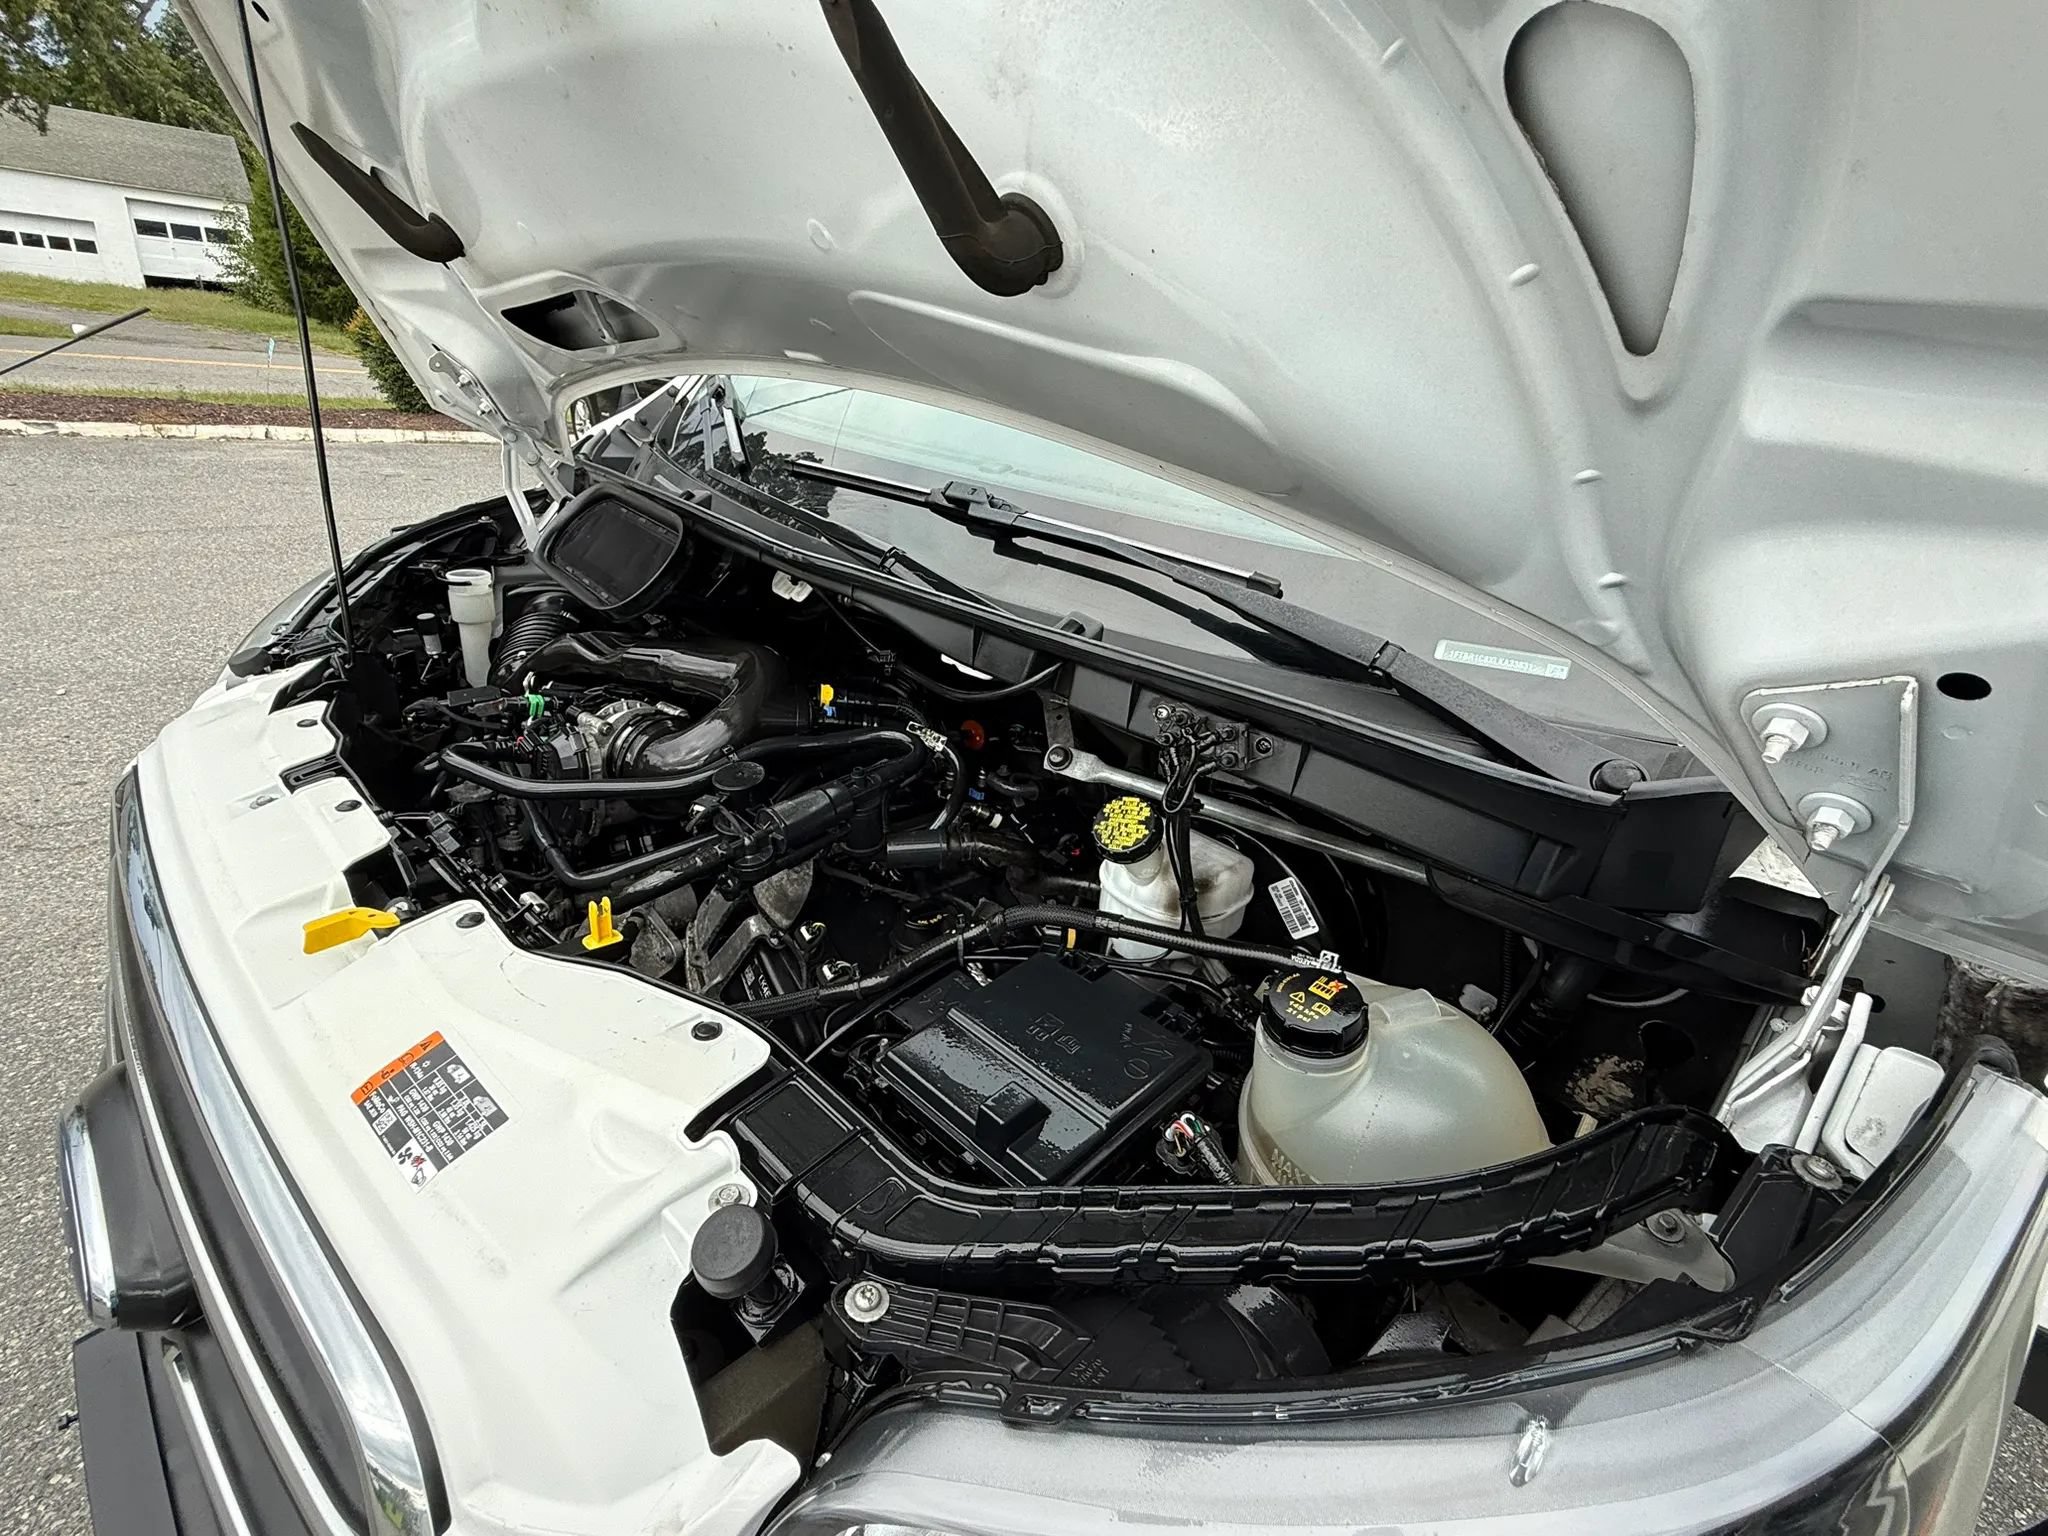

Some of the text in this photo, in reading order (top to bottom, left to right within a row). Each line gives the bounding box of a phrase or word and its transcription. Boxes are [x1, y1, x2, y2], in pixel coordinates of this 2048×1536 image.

[1285, 1008, 1311, 1023] 21 psi
[1289, 1000, 1320, 1020] 145 kPa
[368, 1090, 387, 1113] FoMoCo
